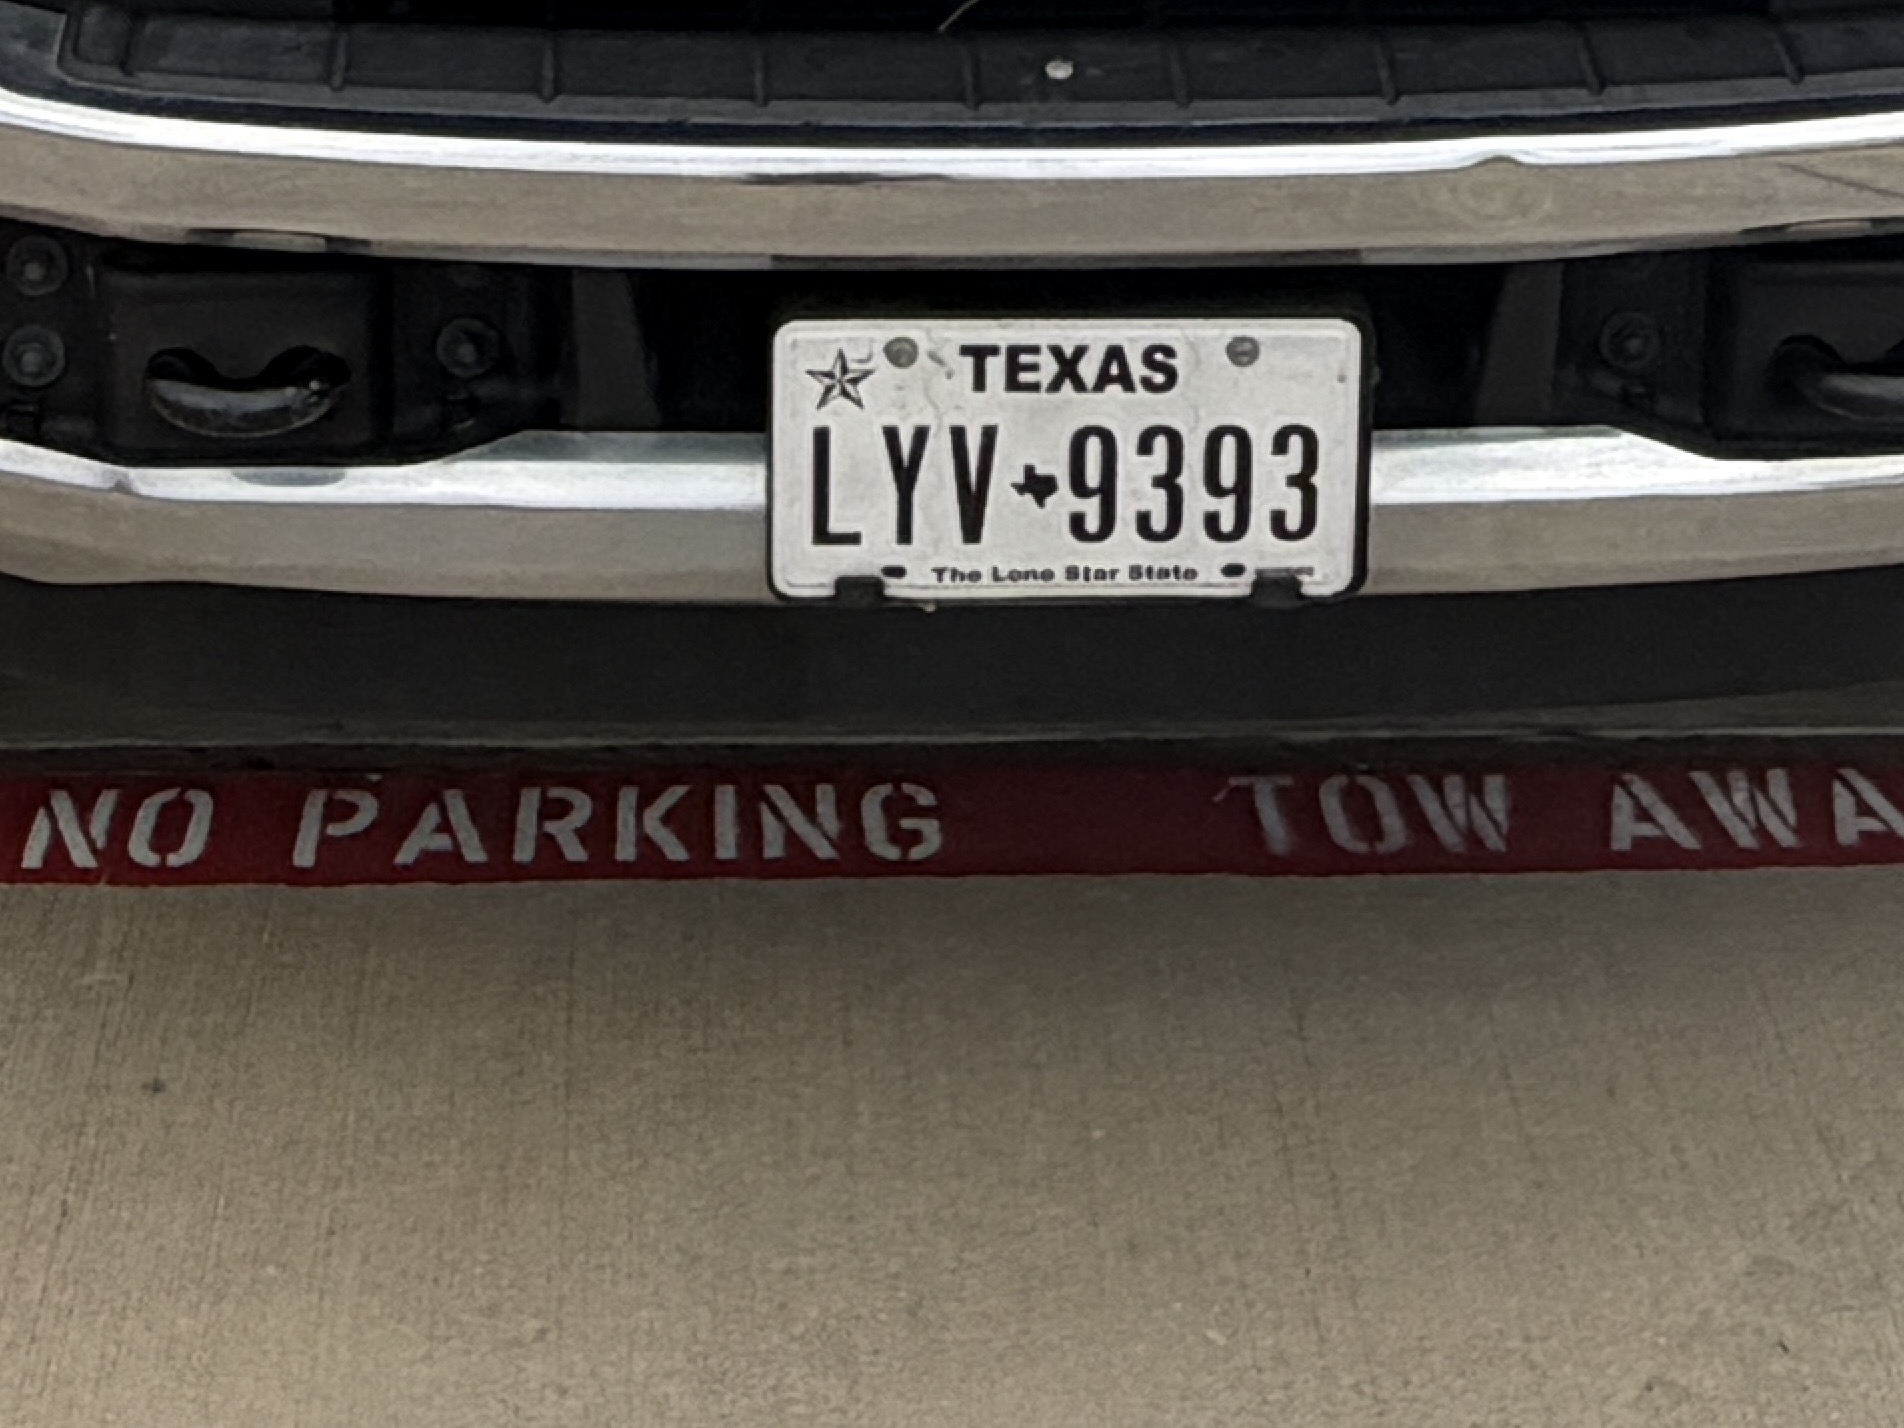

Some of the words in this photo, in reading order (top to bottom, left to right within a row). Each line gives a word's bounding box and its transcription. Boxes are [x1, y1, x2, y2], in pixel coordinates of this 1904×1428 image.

[959, 344, 1179, 394] TEXAS
[930, 565, 983, 584] The
[990, 564, 1056, 584] Lone
[1064, 564, 1121, 584] Star
[1128, 564, 1199, 583] State
[20, 787, 215, 870] NO
[292, 782, 944, 869] PARKING
[1220, 772, 1508, 856] TOW
